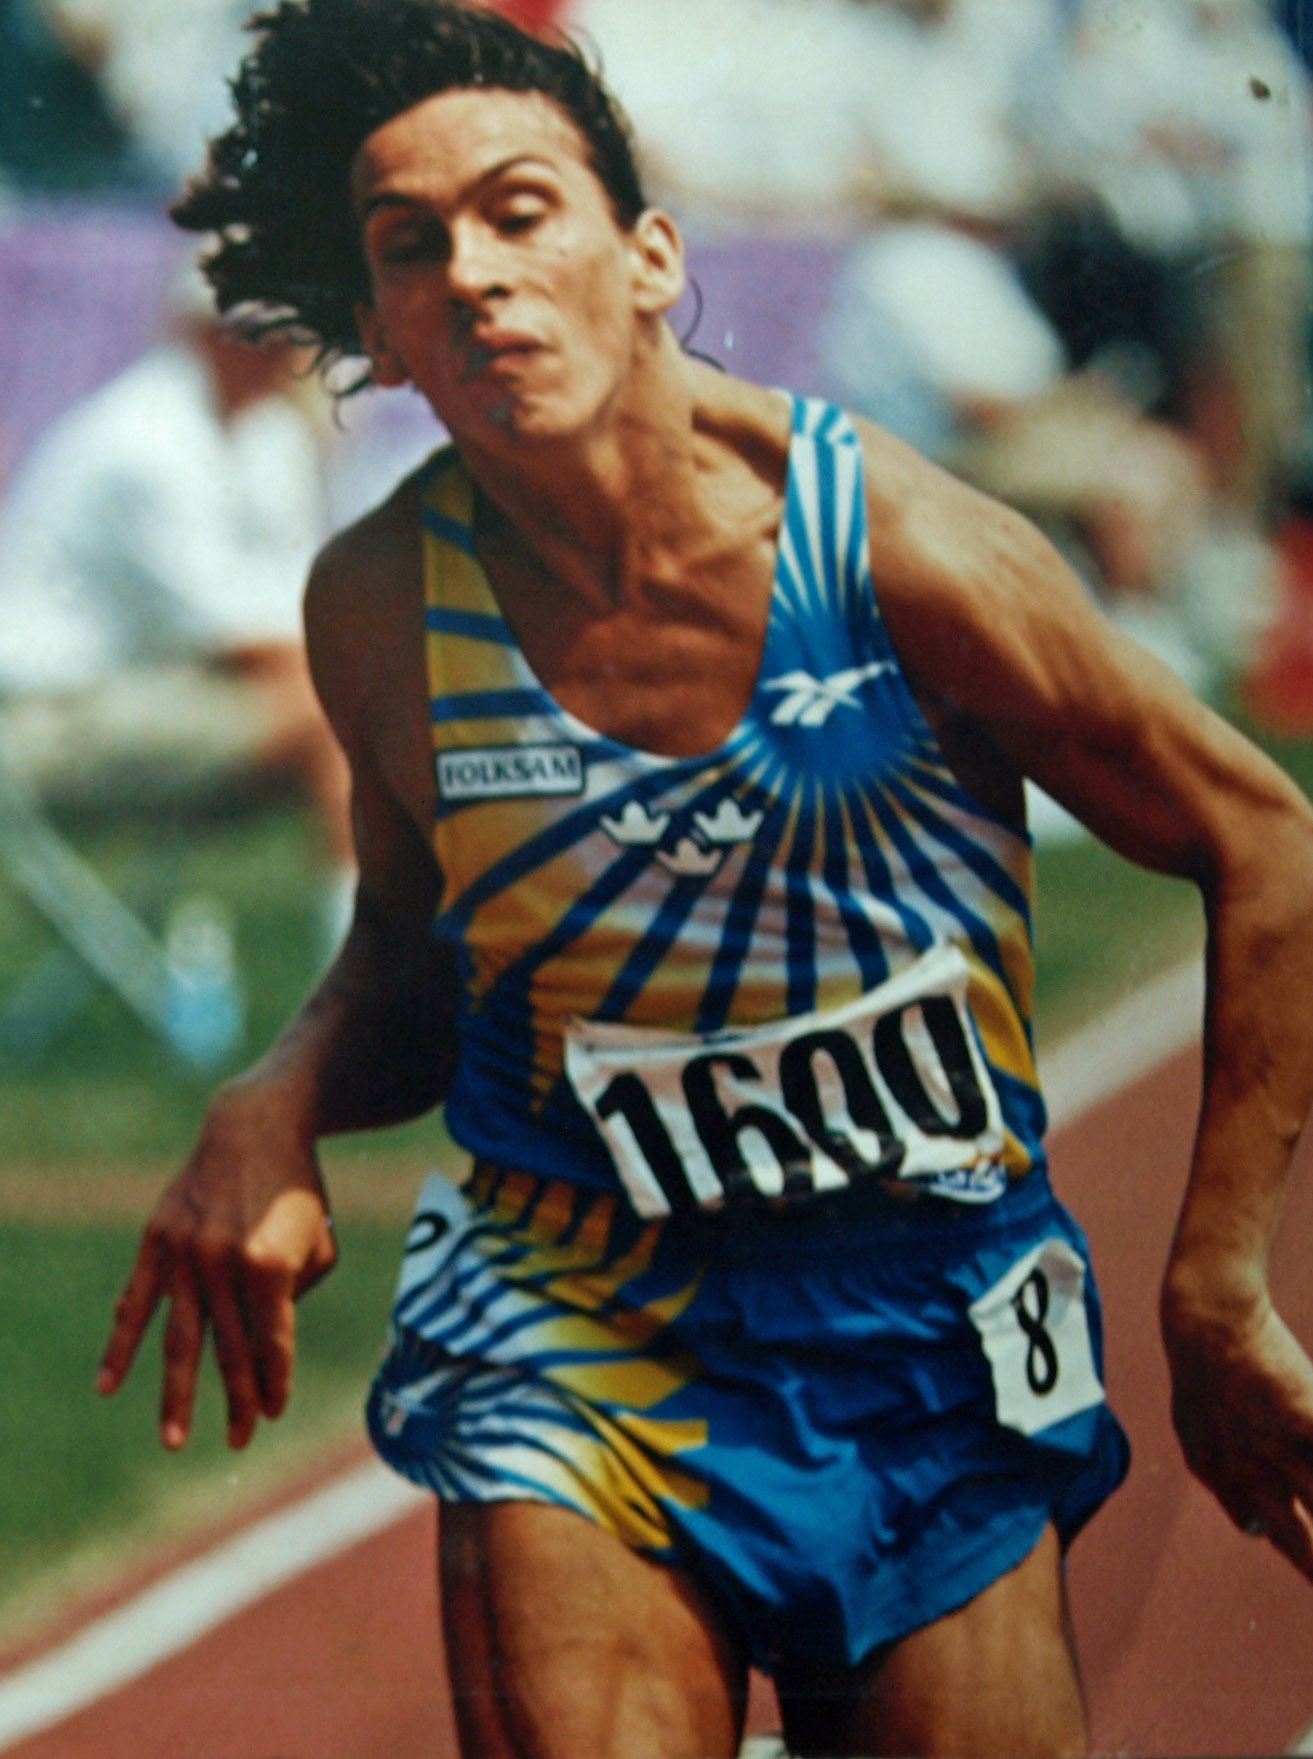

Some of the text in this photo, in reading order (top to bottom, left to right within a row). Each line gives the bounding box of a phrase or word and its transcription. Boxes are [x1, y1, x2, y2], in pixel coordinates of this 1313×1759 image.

[444, 755, 578, 786] FOLKSAM
[595, 996, 988, 1213] 1600
[1009, 1267, 1059, 1398] 8
